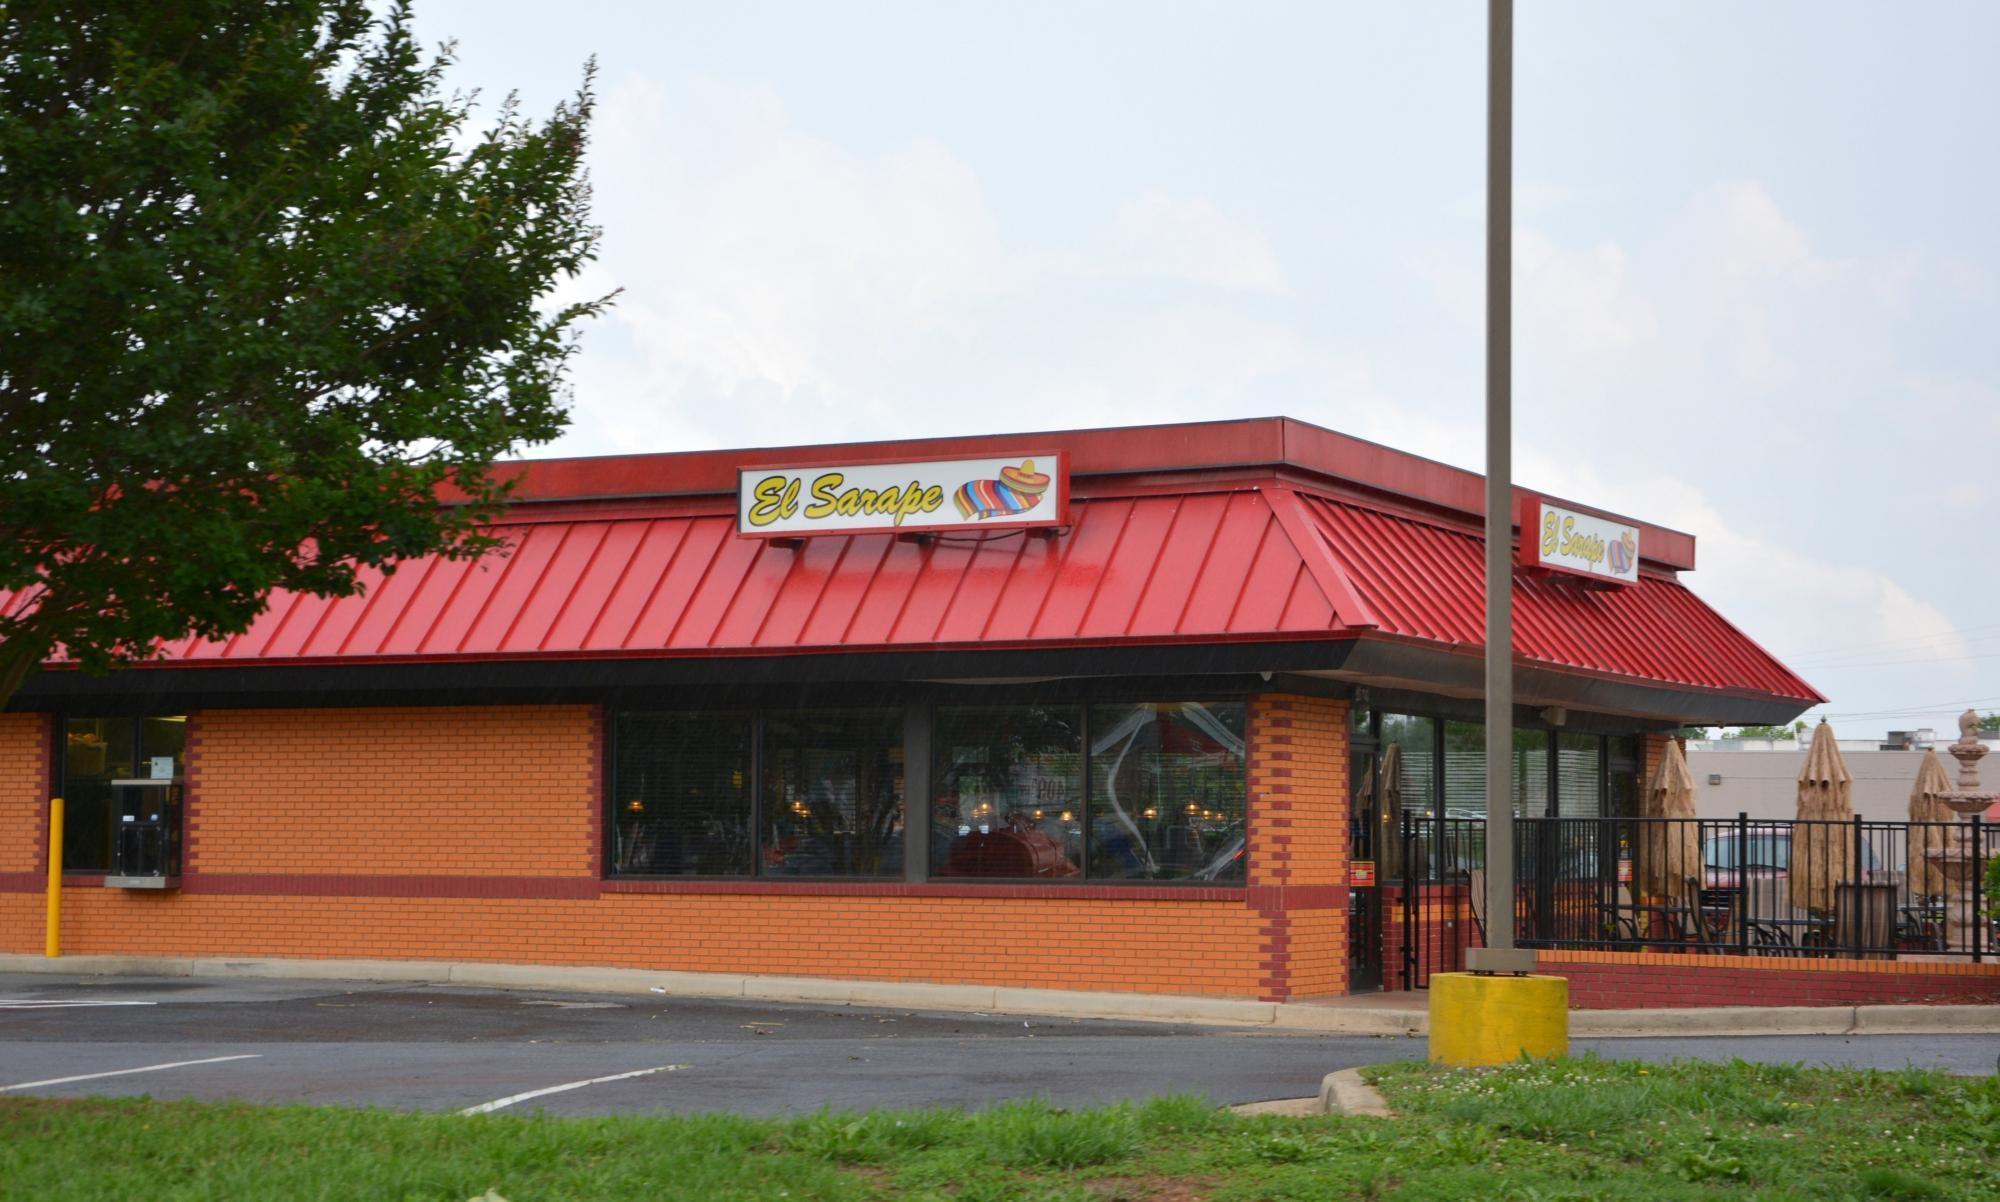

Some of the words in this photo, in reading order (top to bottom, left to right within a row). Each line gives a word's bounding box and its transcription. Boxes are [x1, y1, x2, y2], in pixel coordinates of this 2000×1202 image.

[749, 475, 801, 527] El
[804, 473, 944, 527] Sarape
[1541, 511, 1560, 557] El
